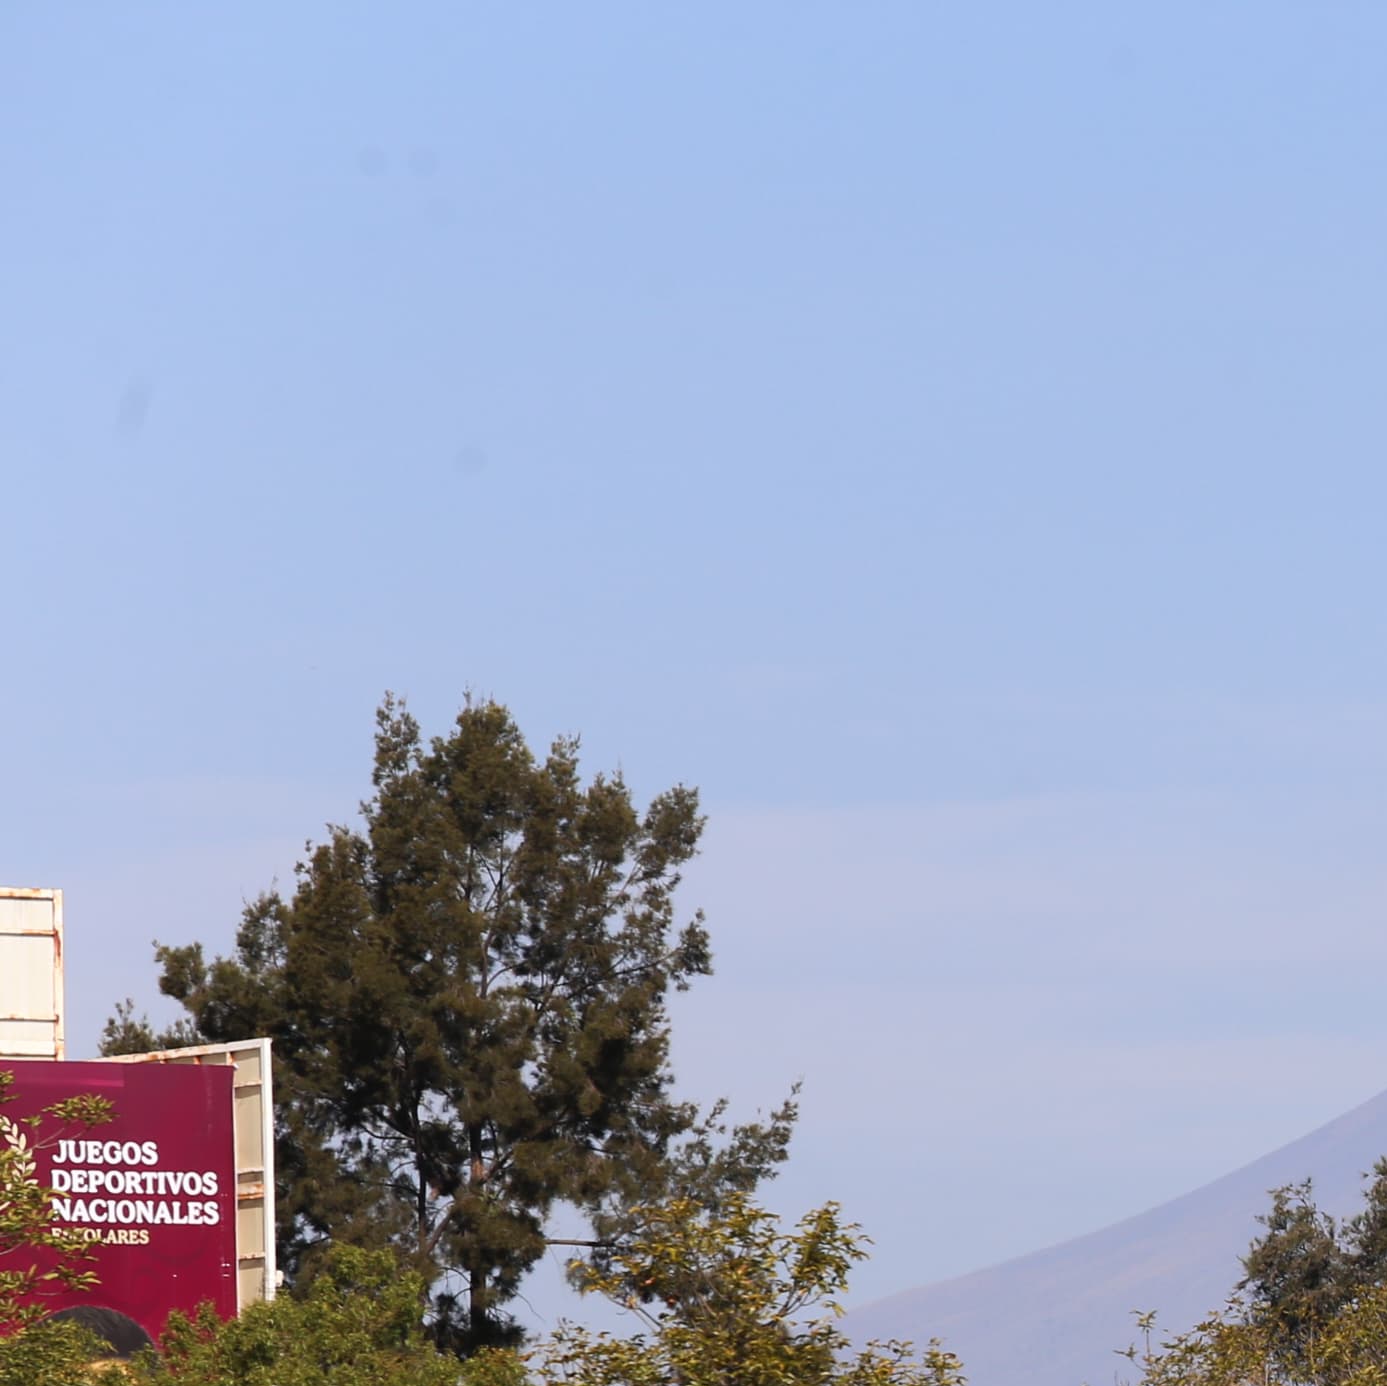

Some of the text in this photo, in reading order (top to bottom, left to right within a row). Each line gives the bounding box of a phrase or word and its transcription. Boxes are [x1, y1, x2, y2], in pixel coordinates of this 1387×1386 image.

[52, 1139, 159, 1165] JUEGOS
[51, 1169, 218, 1196] DEPORTIVOS
[51, 1198, 220, 1225] NACIONALES
[51, 1227, 150, 1245] EOLARES
